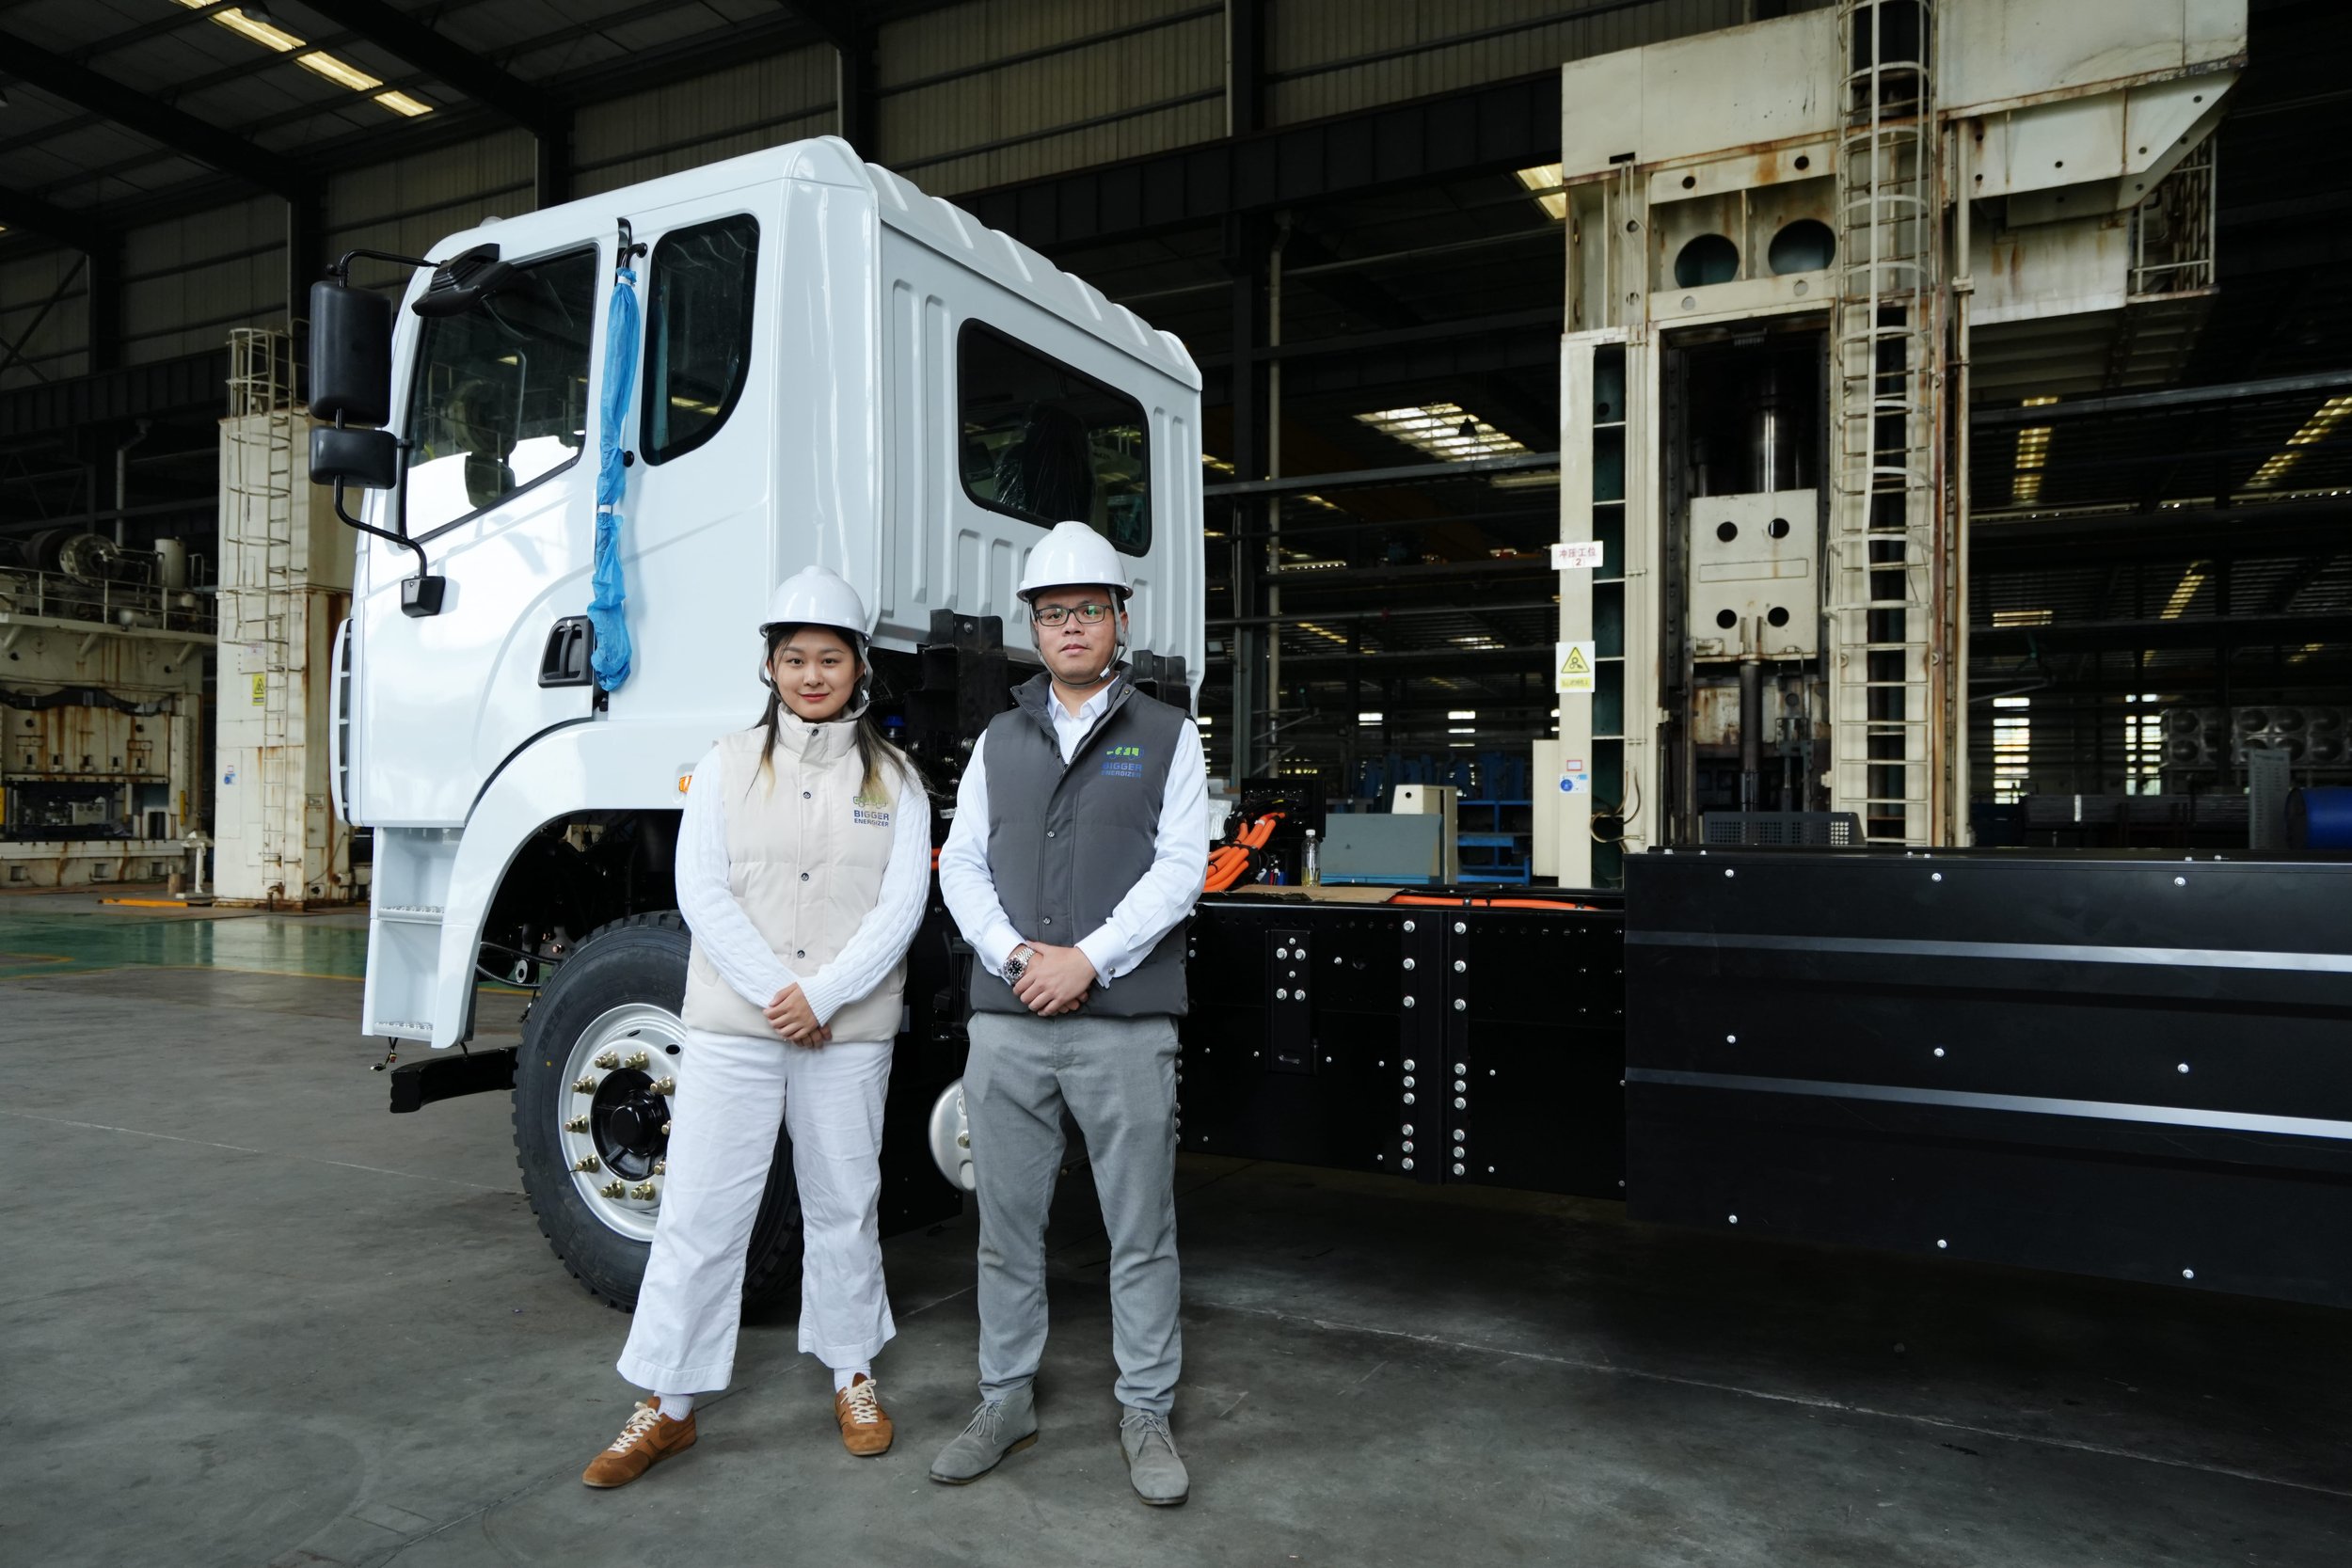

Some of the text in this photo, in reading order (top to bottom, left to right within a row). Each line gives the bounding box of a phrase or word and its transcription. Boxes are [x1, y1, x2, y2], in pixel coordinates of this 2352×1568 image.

[1575, 558, 1581, 566] 2
[1102, 762, 1142, 771] BIGGER
[853, 810, 889, 820] BIGGER
[853, 818, 889, 827] ENERGIZER
